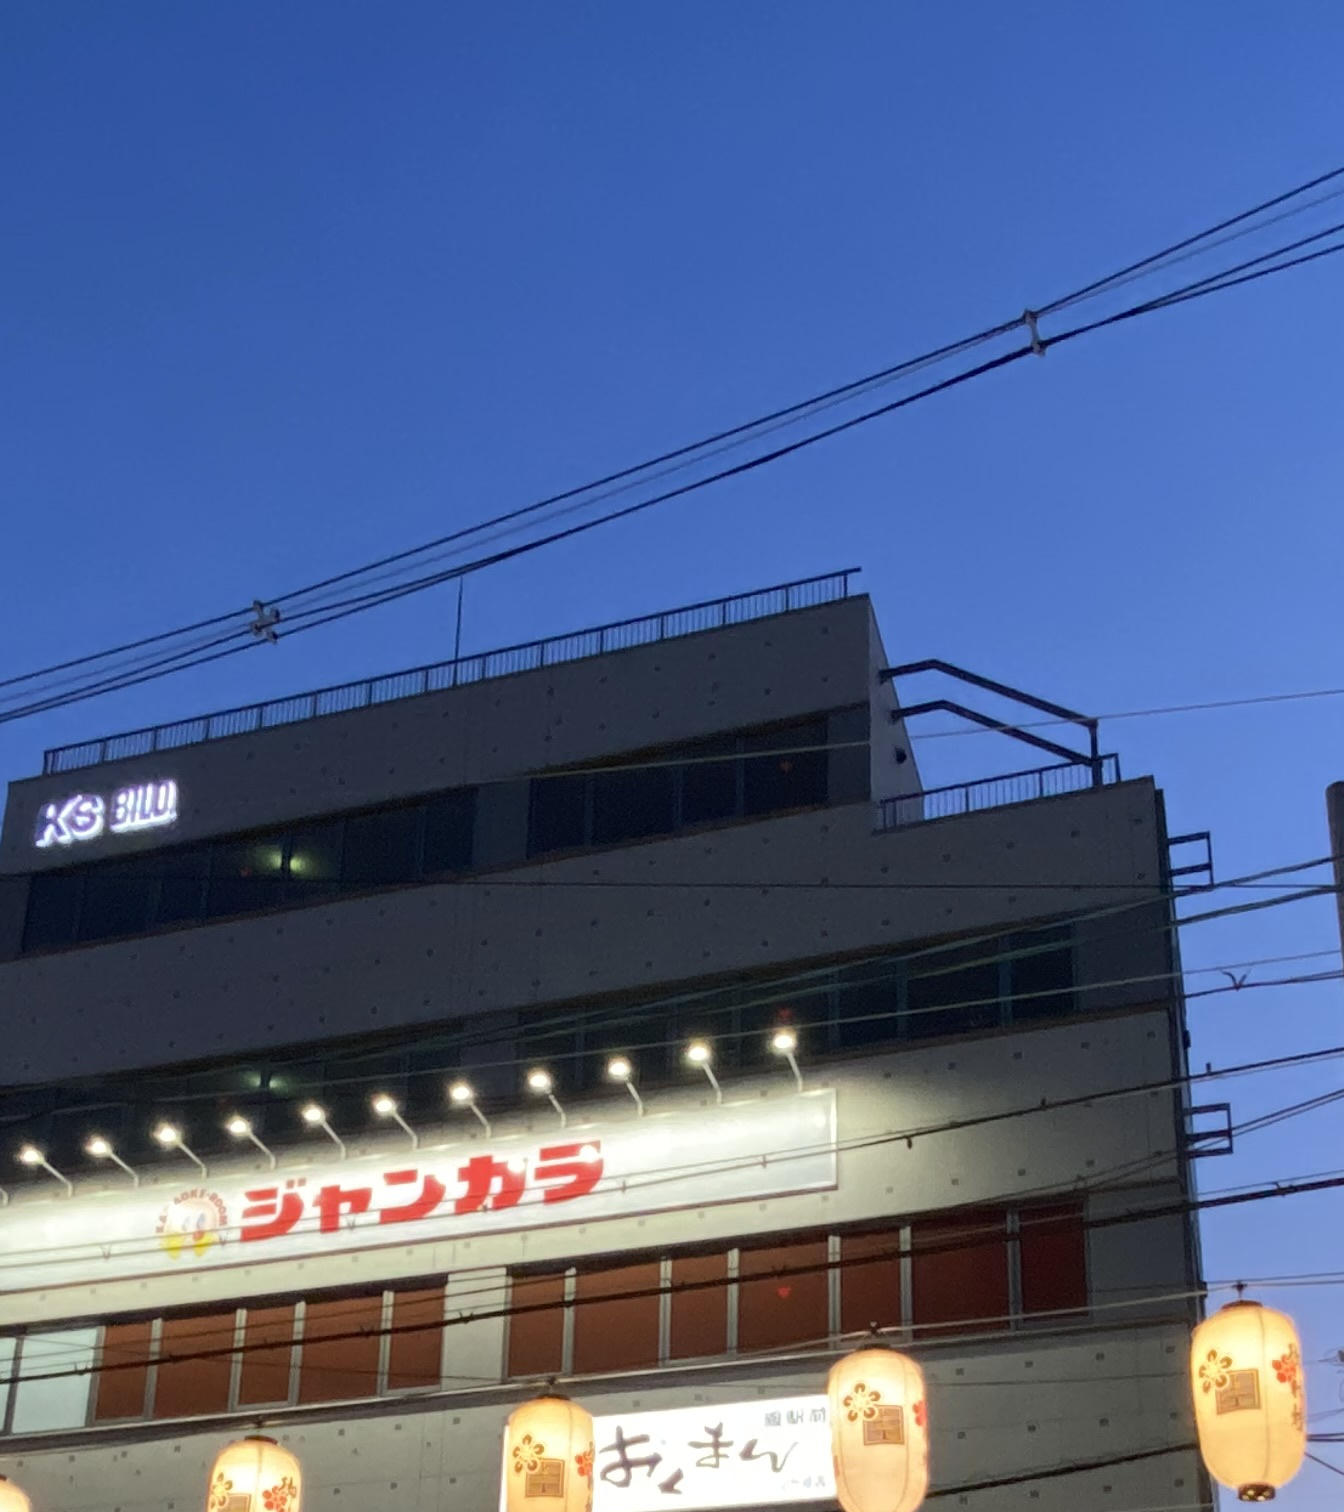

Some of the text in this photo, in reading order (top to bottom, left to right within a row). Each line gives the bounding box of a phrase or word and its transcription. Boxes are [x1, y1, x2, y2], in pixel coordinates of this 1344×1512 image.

[240, 1139, 605, 1243] ジャンカラ
